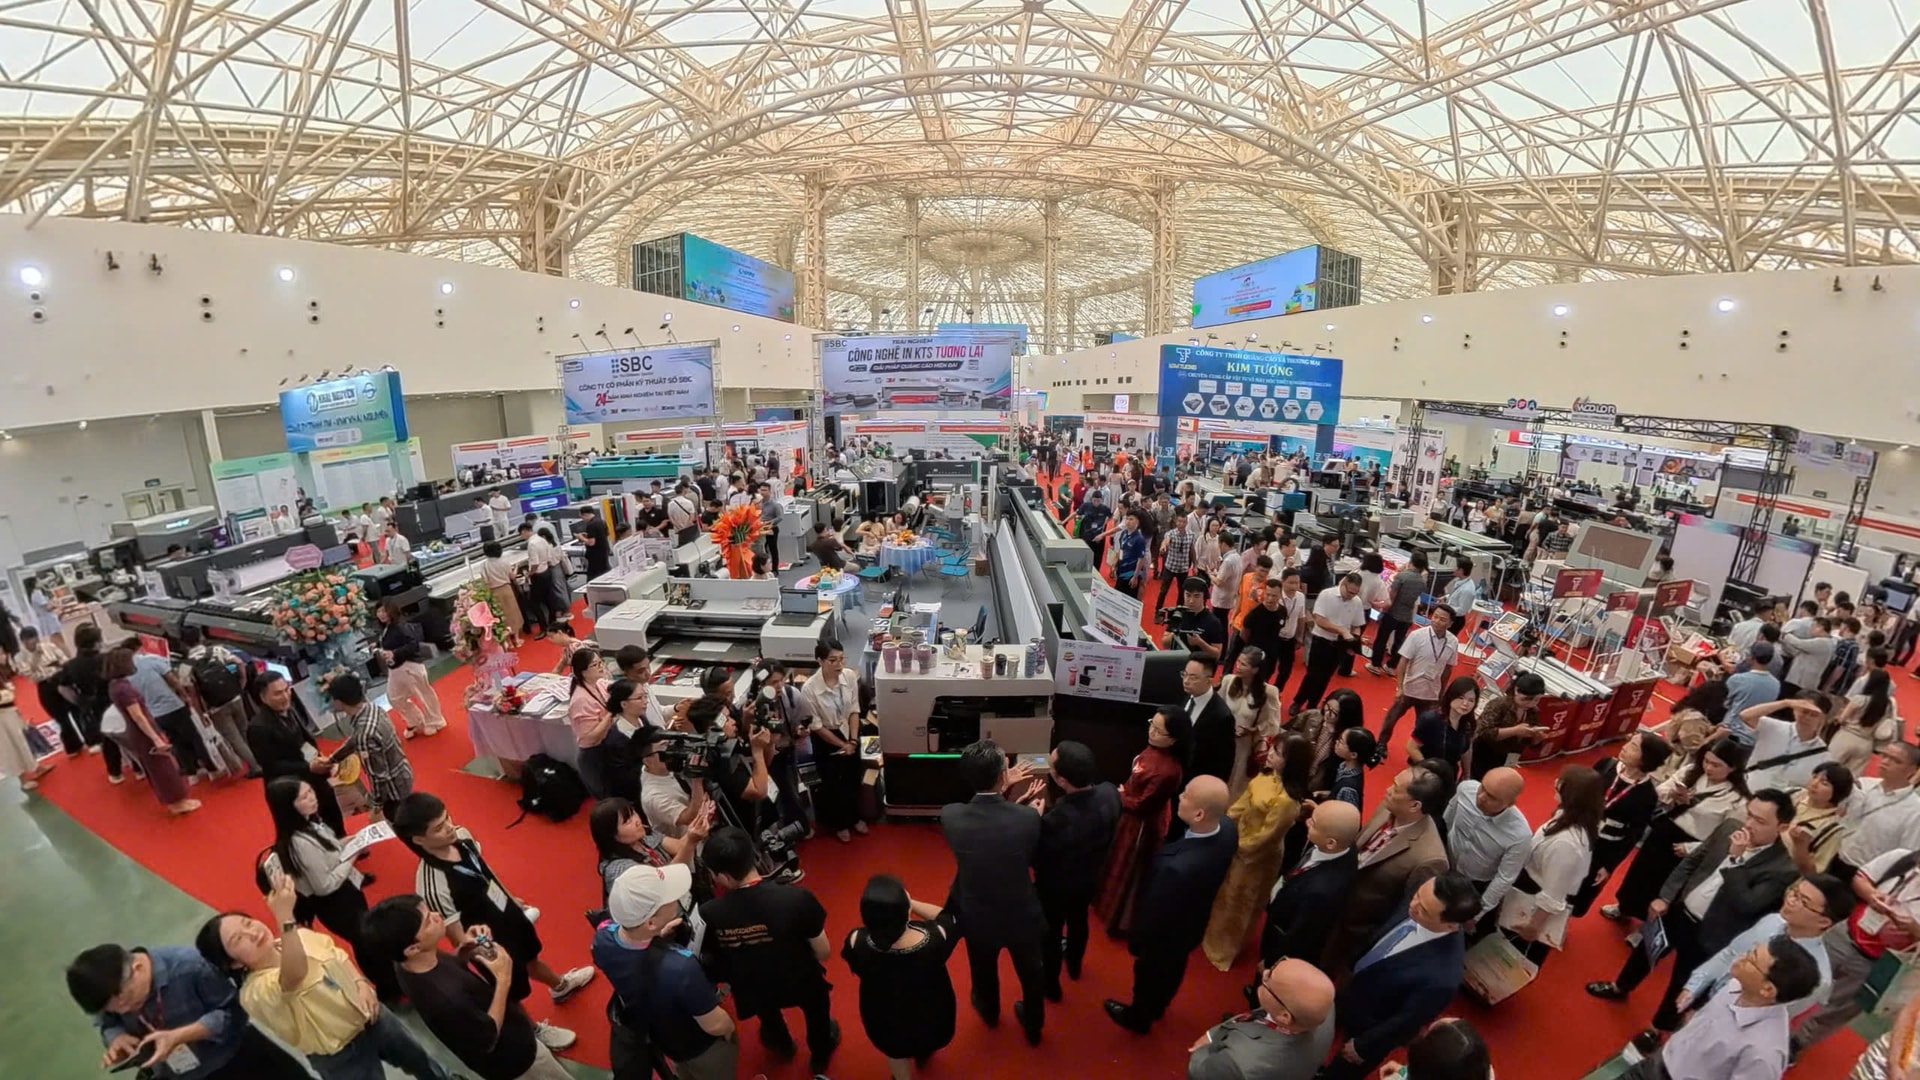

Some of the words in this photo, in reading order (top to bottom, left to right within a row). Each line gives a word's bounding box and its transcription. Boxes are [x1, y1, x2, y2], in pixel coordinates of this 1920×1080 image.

[830, 339, 848, 348] SBC
[848, 347, 873, 362] CÔNG
[875, 344, 900, 362] NGHỆ
[902, 347, 912, 359] IN
[915, 346, 933, 359] KTS
[968, 345, 984, 358] LAI
[1195, 349, 1214, 357] CÔNG
[620, 355, 653, 373] SBC
[1227, 362, 1250, 373] KIM
[1253, 362, 1293, 377] TƯỢNG
[579, 383, 596, 392] CÔNG
